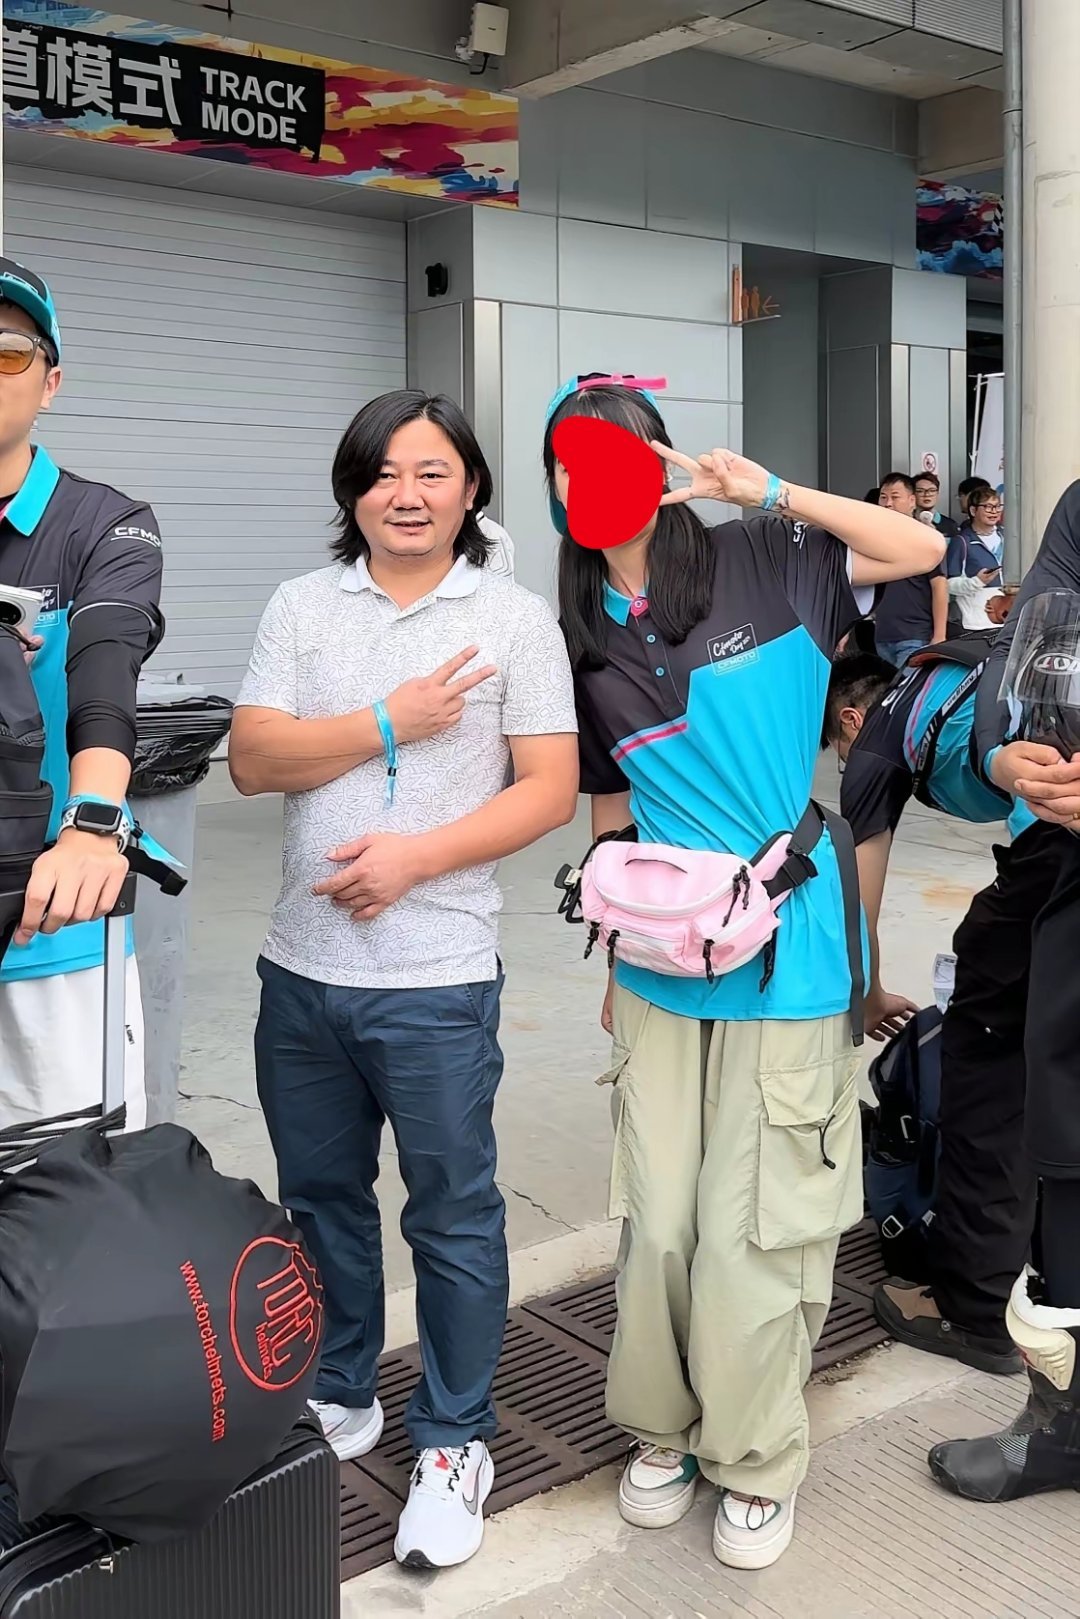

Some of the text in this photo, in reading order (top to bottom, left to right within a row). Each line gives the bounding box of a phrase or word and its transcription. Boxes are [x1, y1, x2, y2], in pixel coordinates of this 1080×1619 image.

[199, 65, 308, 113] TRACK
[201, 100, 298, 145] MODE
[179, 1260, 227, 1443] www.torchelmets.com
[255, 1321, 273, 1379] helmets
